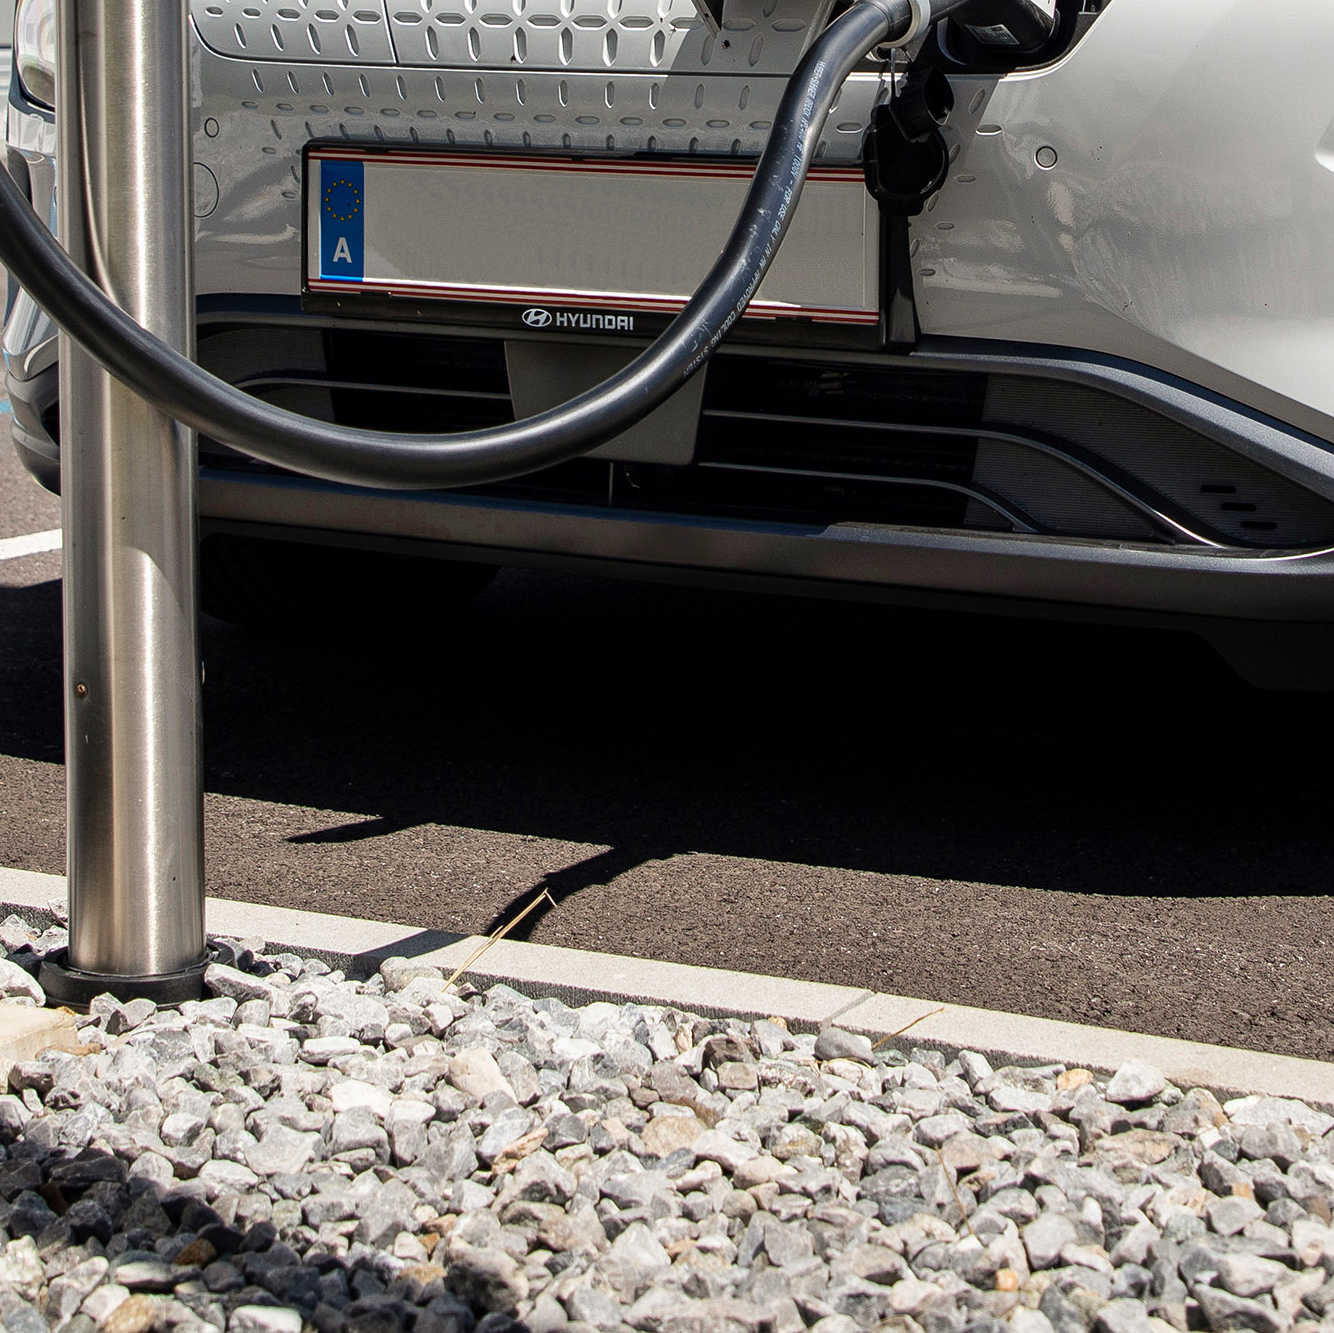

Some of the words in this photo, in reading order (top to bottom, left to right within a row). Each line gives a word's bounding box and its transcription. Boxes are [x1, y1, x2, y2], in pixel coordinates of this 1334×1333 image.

[790, 155, 802, 179] 1000V
[783, 186, 793, 204] FOR
[778, 203, 787, 221] USE
[770, 220, 782, 244] ONLY
[332, 237, 352, 263] A
[556, 312, 634, 331] HYUNDAI
